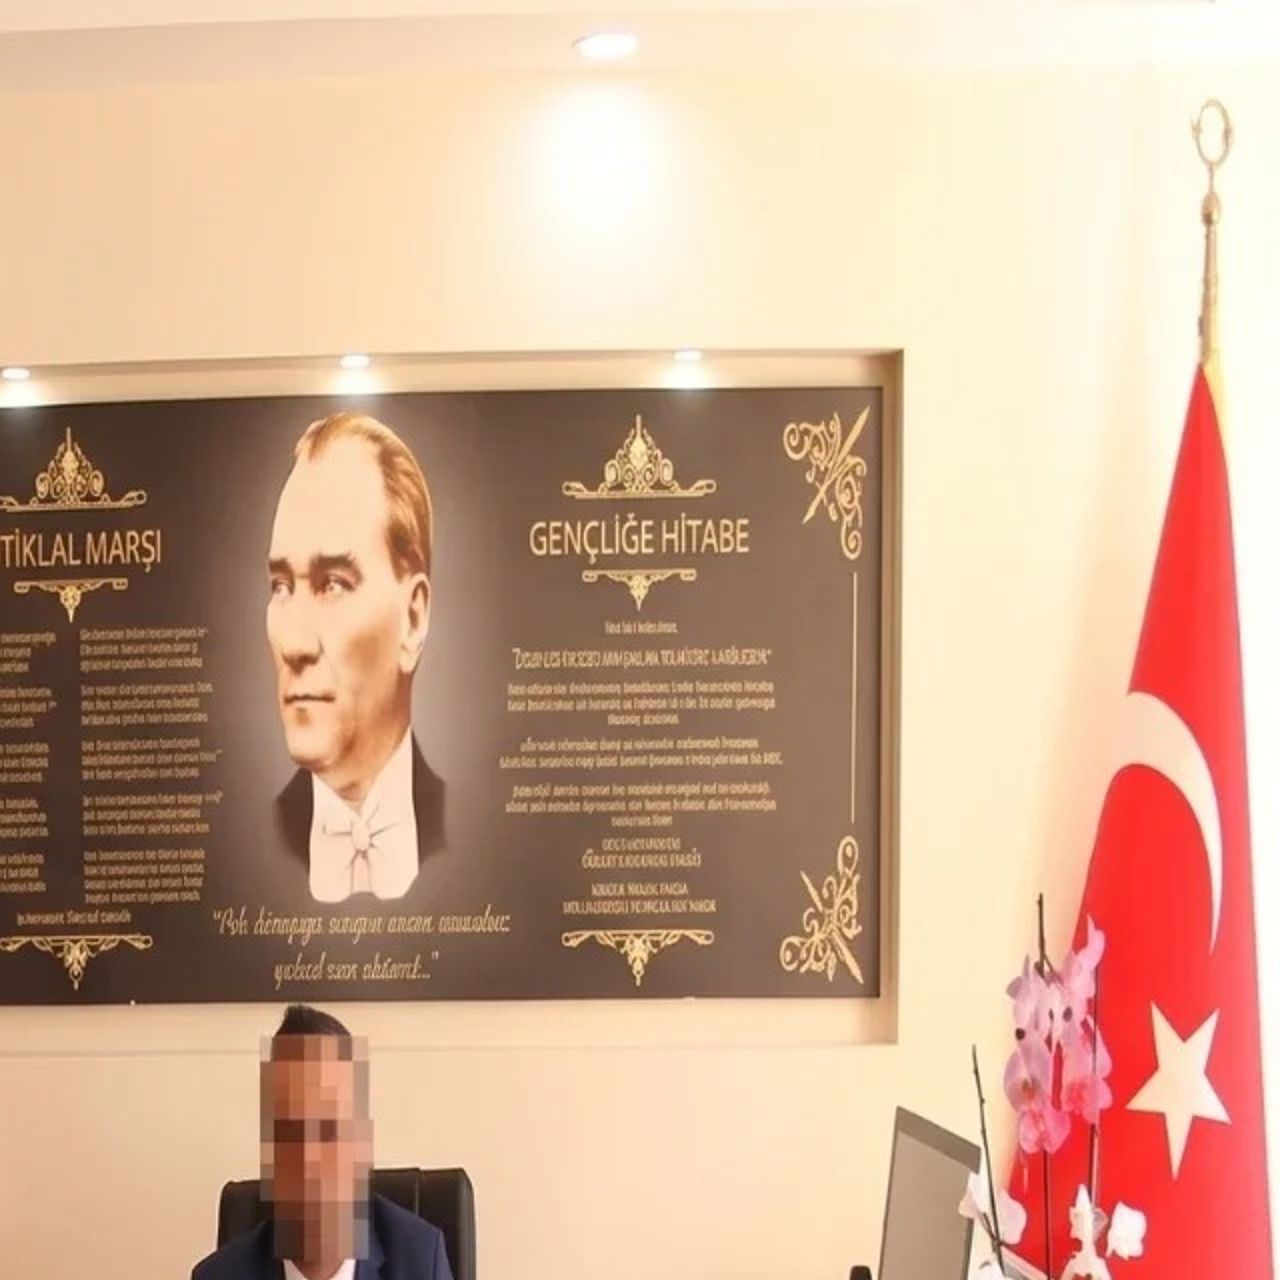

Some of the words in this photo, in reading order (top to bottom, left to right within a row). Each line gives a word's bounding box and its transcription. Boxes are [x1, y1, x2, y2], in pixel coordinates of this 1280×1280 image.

[86, 529, 161, 573] MARŞI
[529, 512, 654, 564] GENÇLİĞE
[661, 512, 750, 553] HİTABE
